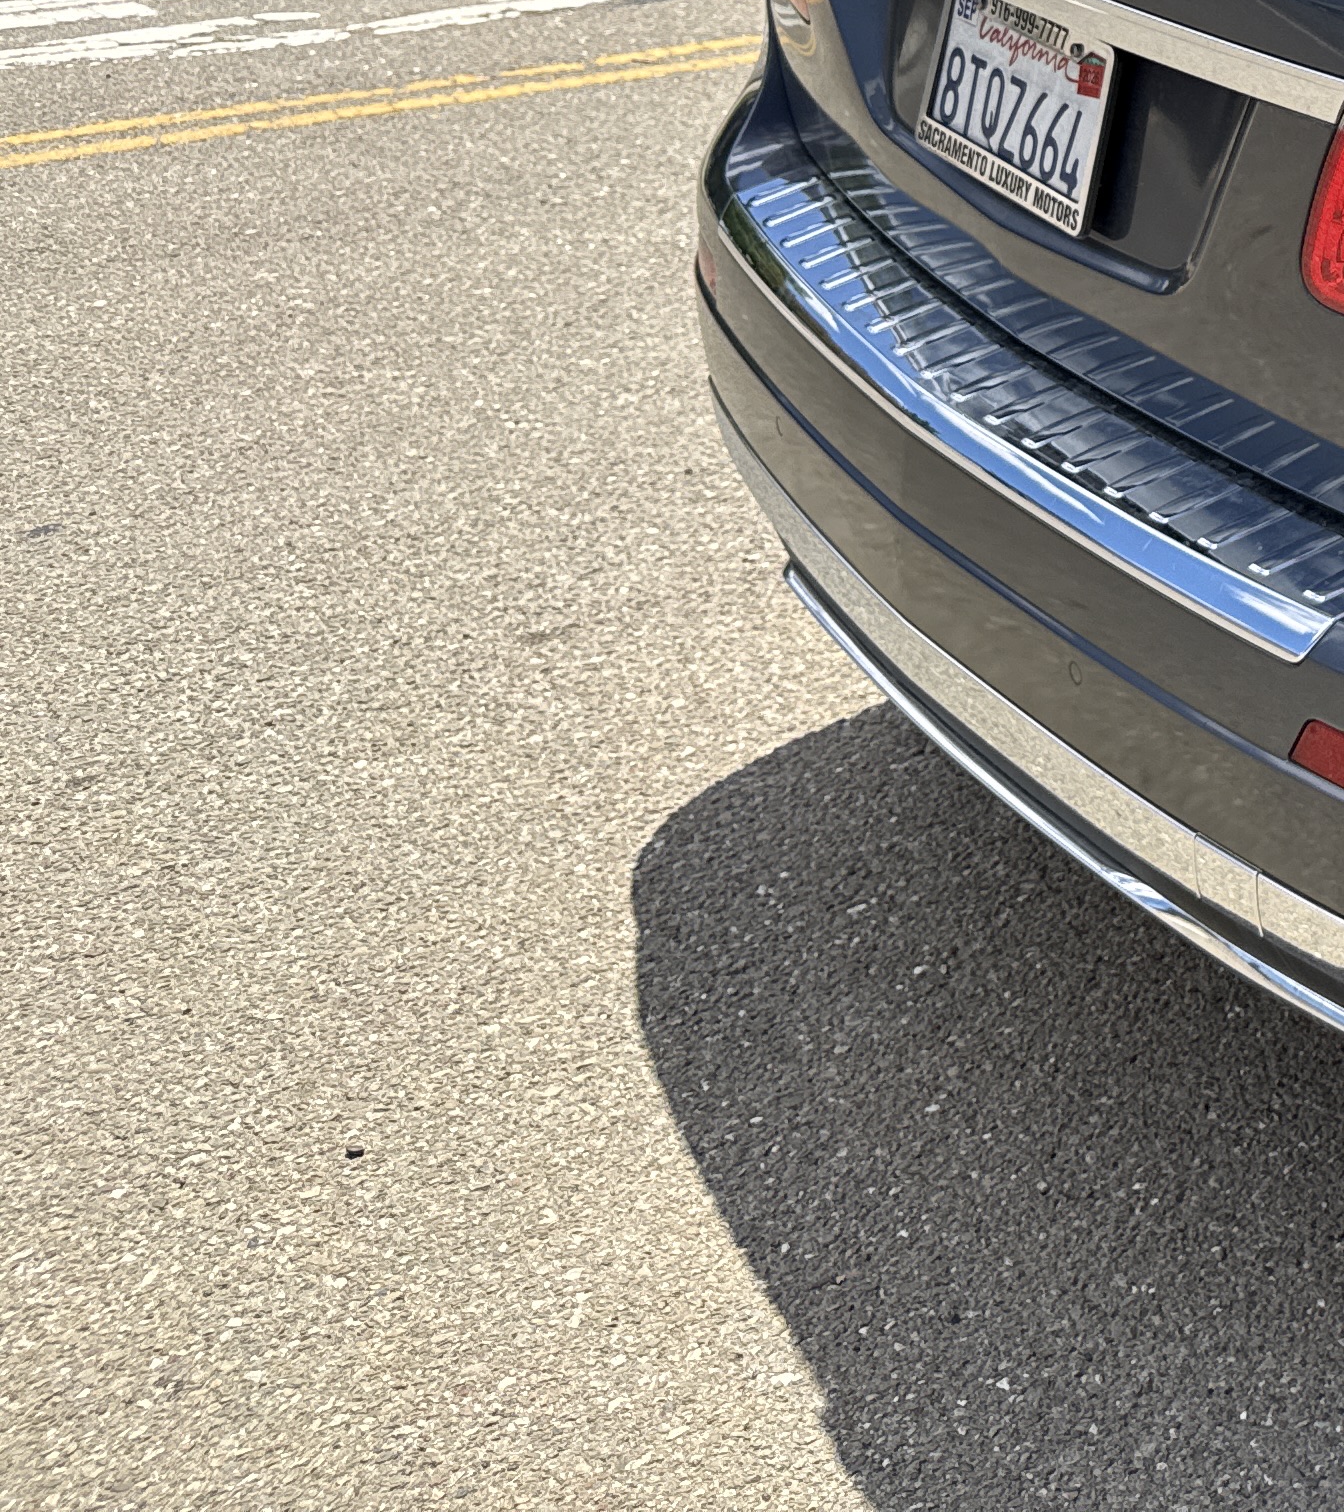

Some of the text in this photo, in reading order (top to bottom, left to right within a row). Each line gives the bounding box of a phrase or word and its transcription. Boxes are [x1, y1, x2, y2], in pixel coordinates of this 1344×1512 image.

[979, 16, 1078, 82] California
[918, 120, 1079, 232] SACRAMENTO LUXURY MOTORS
[939, 47, 1083, 196] 8TQZ664
